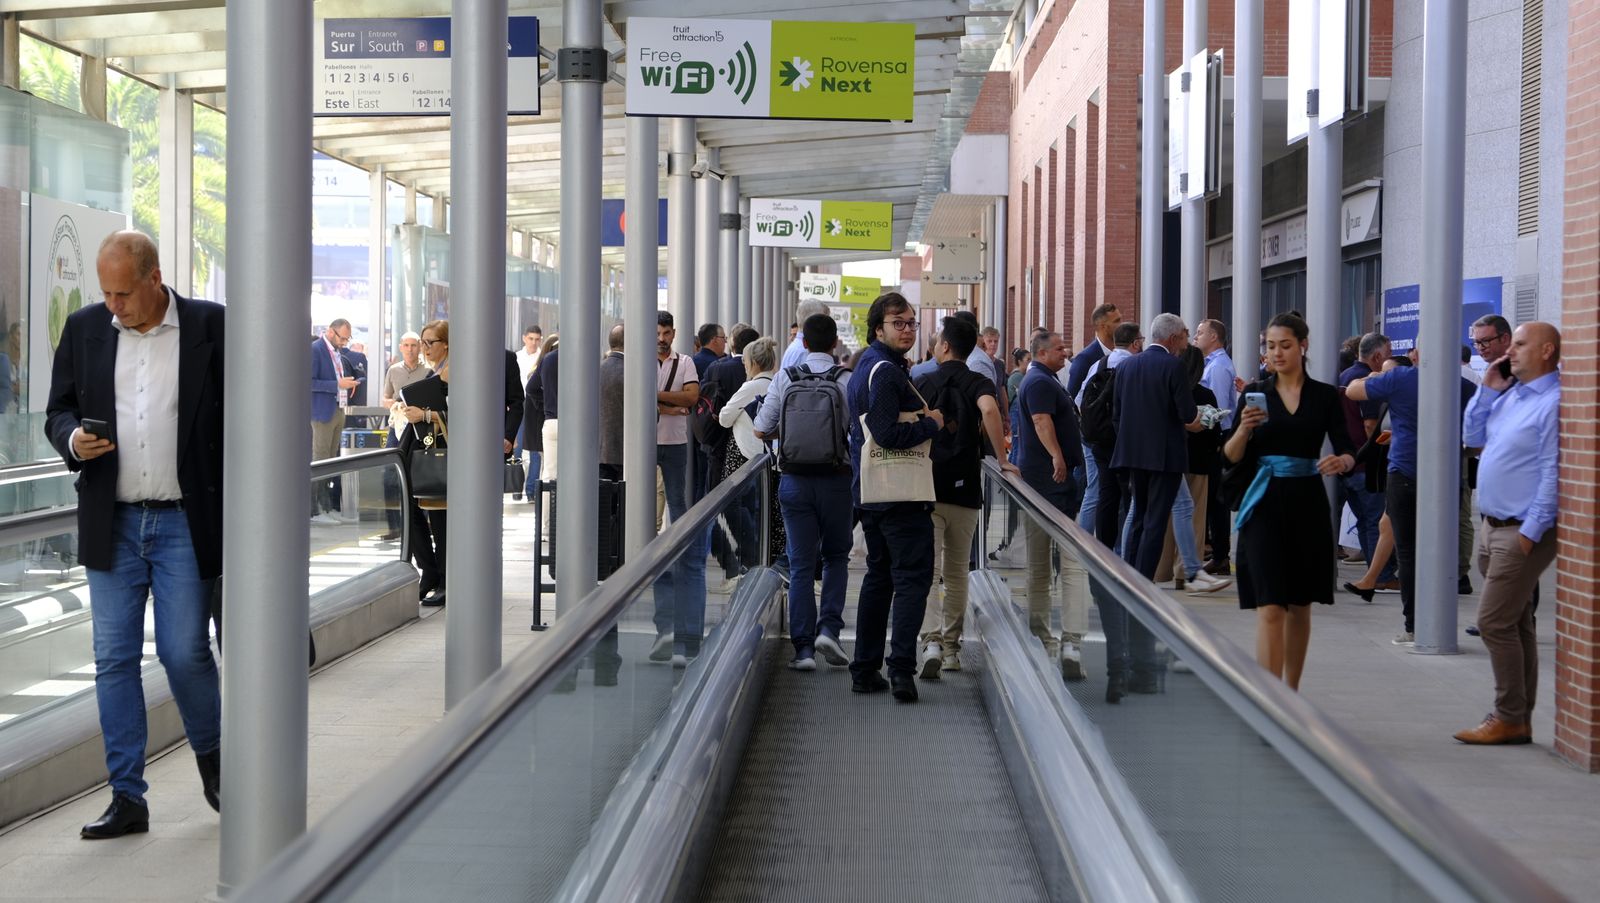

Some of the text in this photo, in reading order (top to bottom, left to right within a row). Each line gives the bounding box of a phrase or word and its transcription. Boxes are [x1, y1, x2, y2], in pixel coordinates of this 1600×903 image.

[673, 25, 690, 33] fruit
[331, 31, 355, 39] Puerta
[672, 33, 715, 42] attraction
[331, 41, 355, 53] Sur
[368, 40, 404, 53] South
[640, 47, 682, 62] Free
[821, 57, 907, 74] Rovensa
[330, 73, 410, 83] 1 2 3 4 5 6
[640, 65, 708, 89] WiFi
[821, 77, 872, 93] Next
[325, 98, 451, 109] Este East 12 14
[324, 176, 338, 186] 14
[757, 222, 791, 233] WiFi
[845, 218, 888, 228] Rovensa
[845, 229, 871, 237] Next
